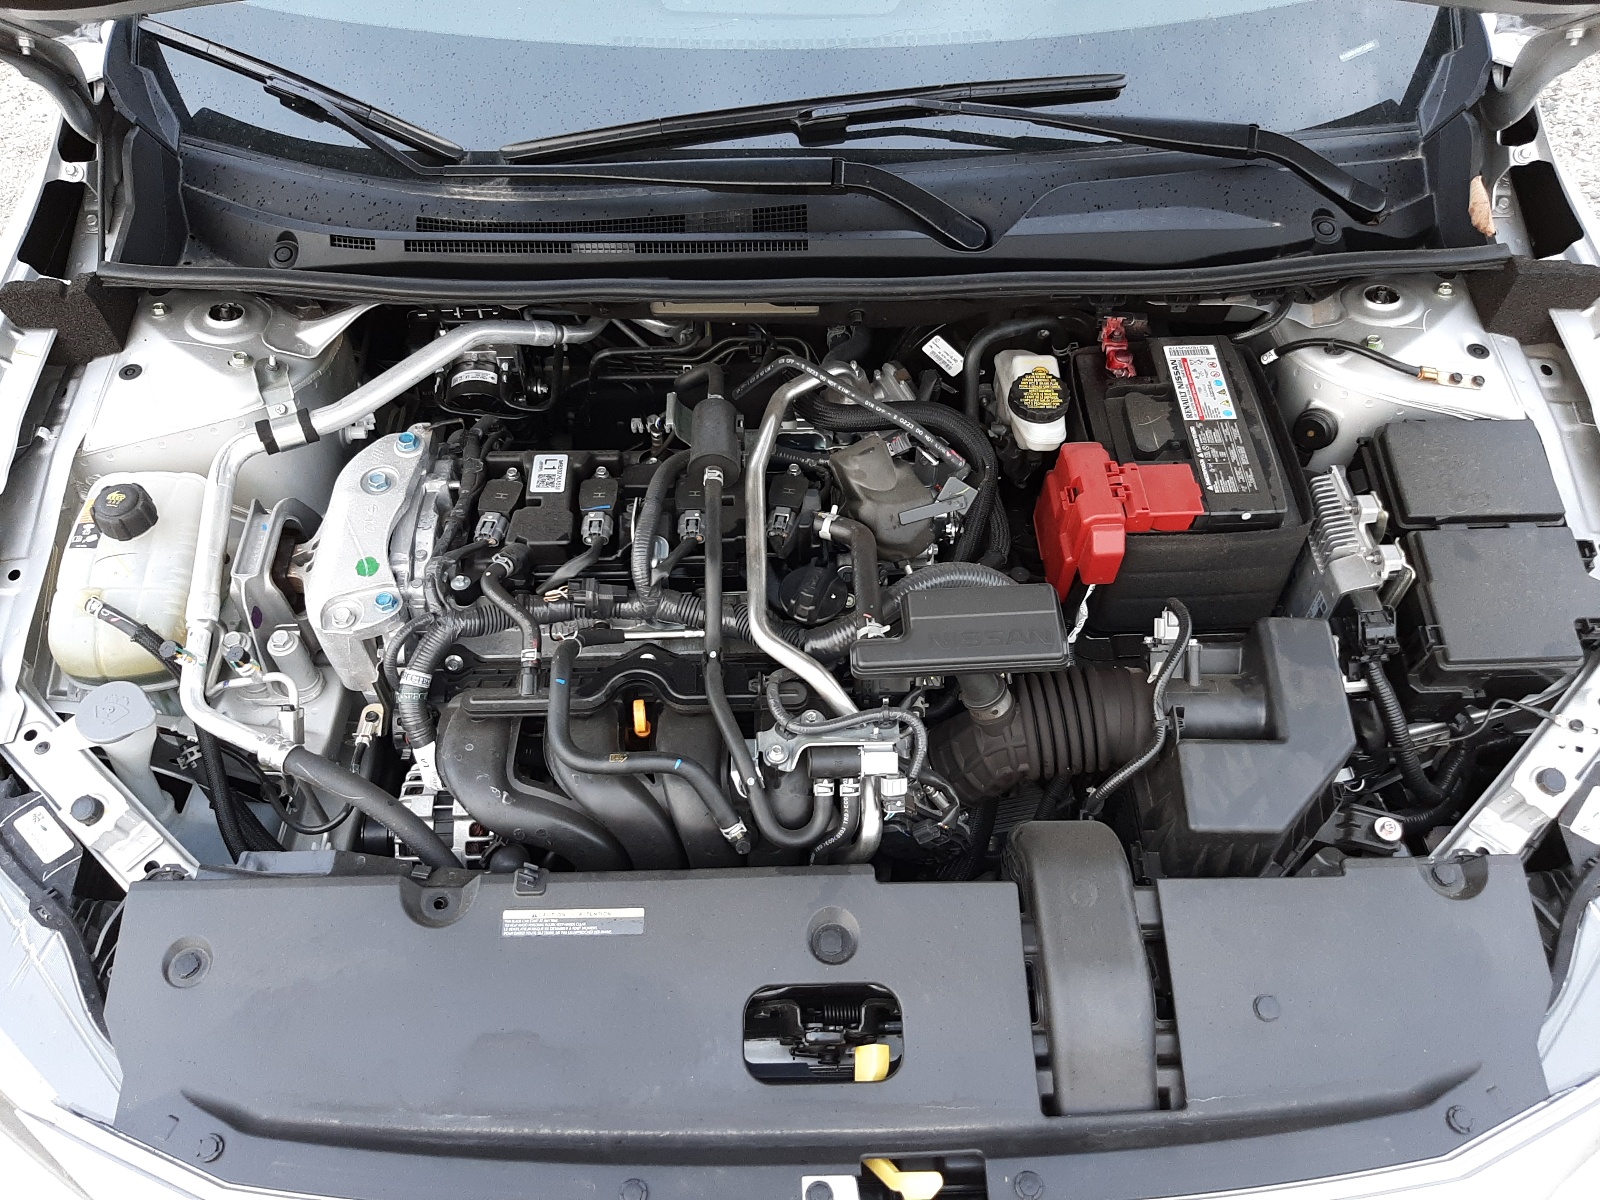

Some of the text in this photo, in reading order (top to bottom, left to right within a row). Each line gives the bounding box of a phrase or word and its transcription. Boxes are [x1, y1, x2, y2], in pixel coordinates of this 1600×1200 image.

[1169, 359, 1184, 390] NISSAN
[1179, 391, 1194, 419] RENAULT
[930, 628, 1055, 651] NISSAN
